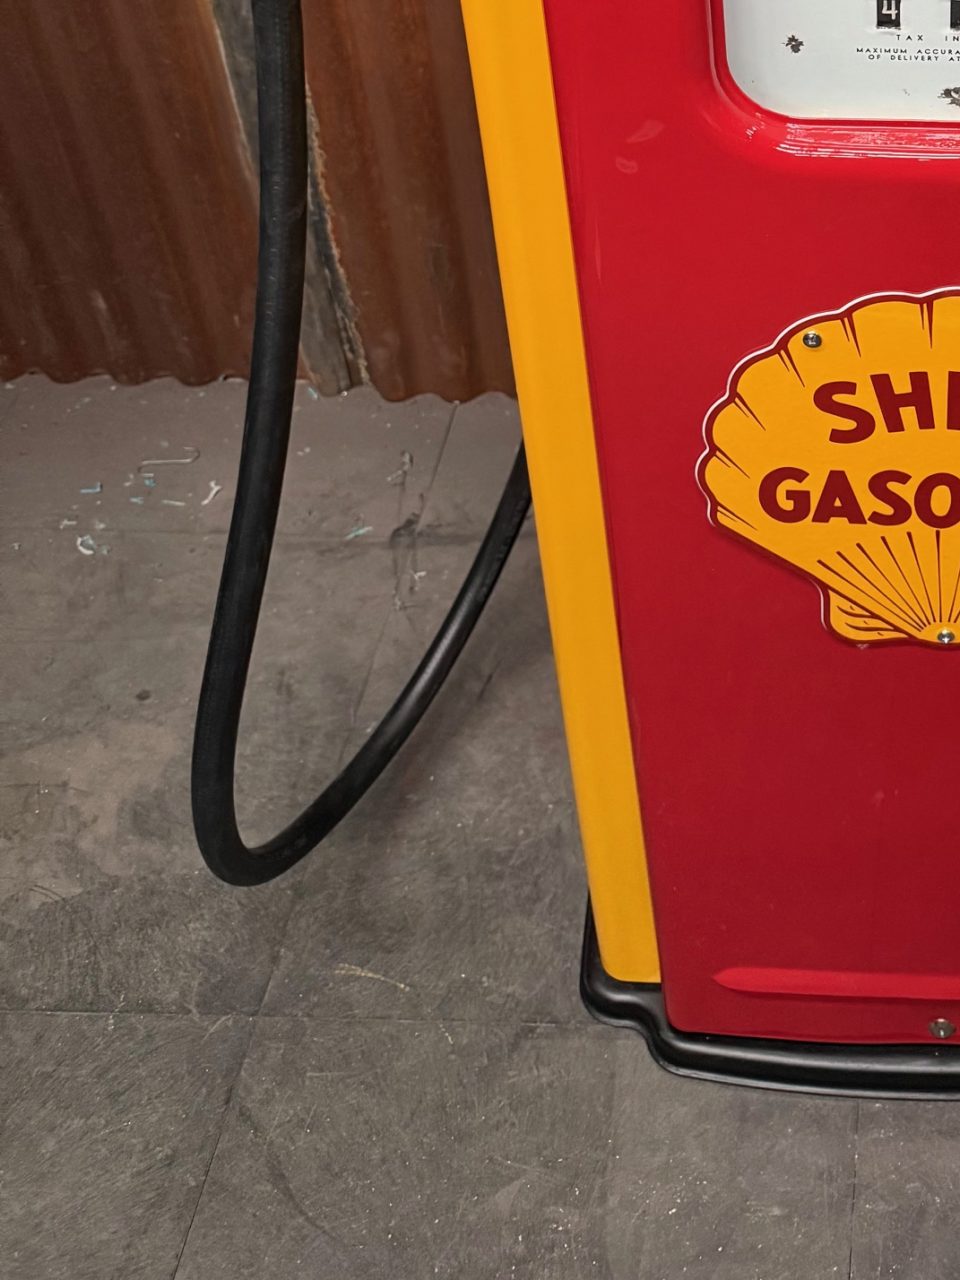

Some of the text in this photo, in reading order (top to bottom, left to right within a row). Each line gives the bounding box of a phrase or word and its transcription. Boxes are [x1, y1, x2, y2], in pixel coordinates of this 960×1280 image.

[896, 33, 924, 42] TAX
[856, 47, 908, 55] MAXIMUM
[890, 54, 939, 62] DELIVERY
